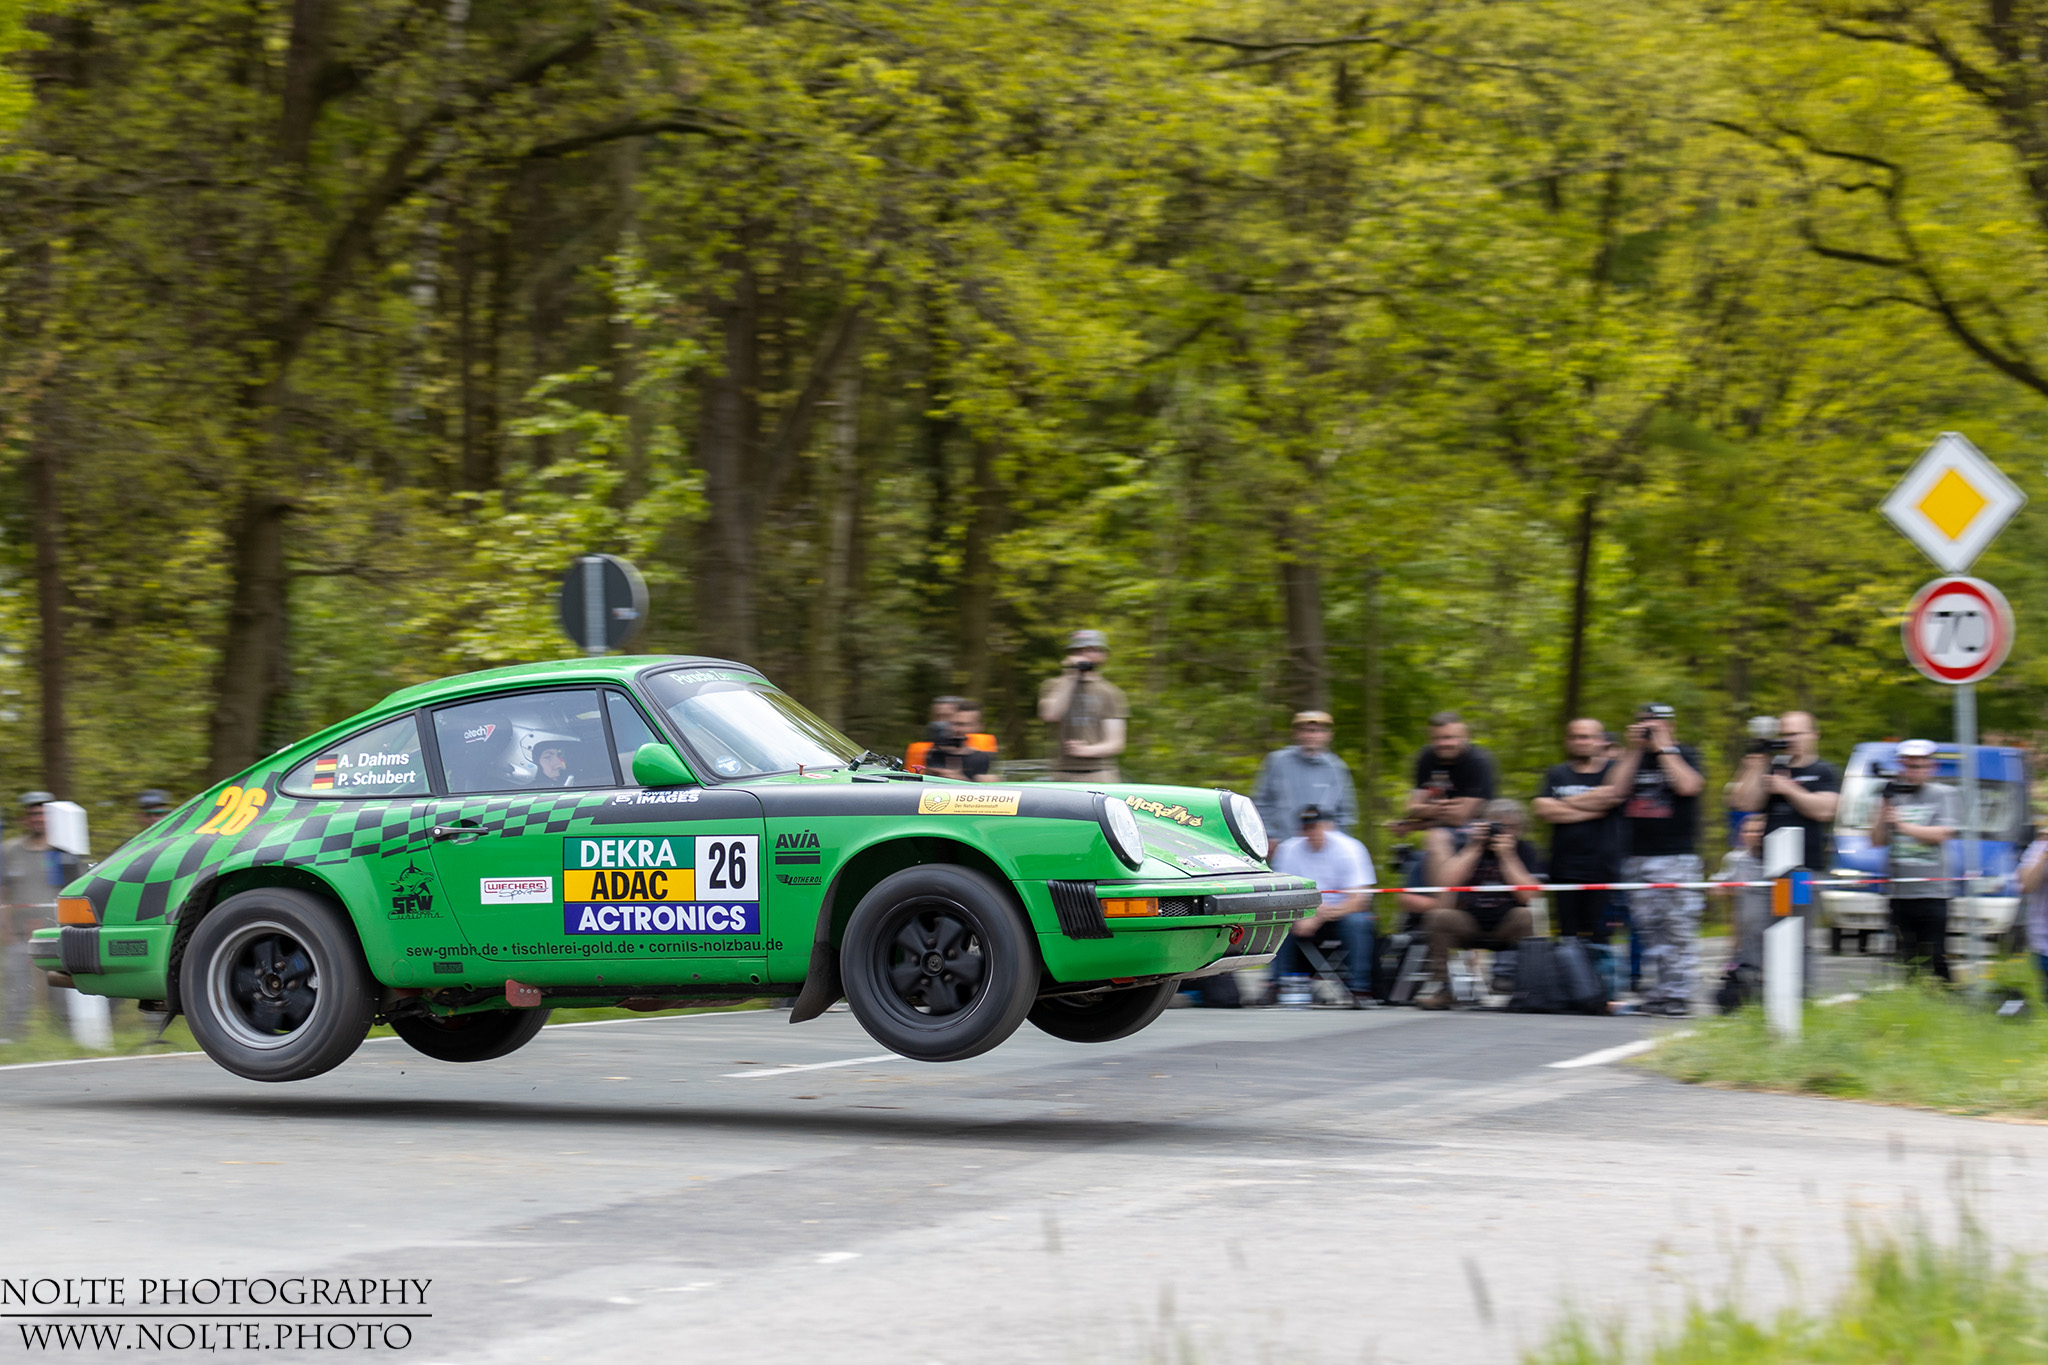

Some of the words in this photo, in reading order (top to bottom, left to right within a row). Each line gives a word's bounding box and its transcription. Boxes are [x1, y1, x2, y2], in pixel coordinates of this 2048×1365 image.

[1924, 610, 1988, 654] 70
[338, 755, 354, 768] A.
[358, 753, 409, 767] Dahms
[337, 773, 349, 786] P.
[352, 771, 416, 785] Schubert
[636, 793, 699, 804] IMAGES
[956, 794, 1015, 803] ISO-STROH
[194, 786, 268, 836] 26
[580, 839, 677, 868] DEKRA
[708, 841, 747, 890] 26
[590, 870, 668, 901] ADAC
[392, 894, 433, 915] SEW
[578, 904, 747, 932] ACTRONICS
[406, 943, 499, 959] sew-gmbh.de
[511, 939, 635, 957] tischlerei-gold.de
